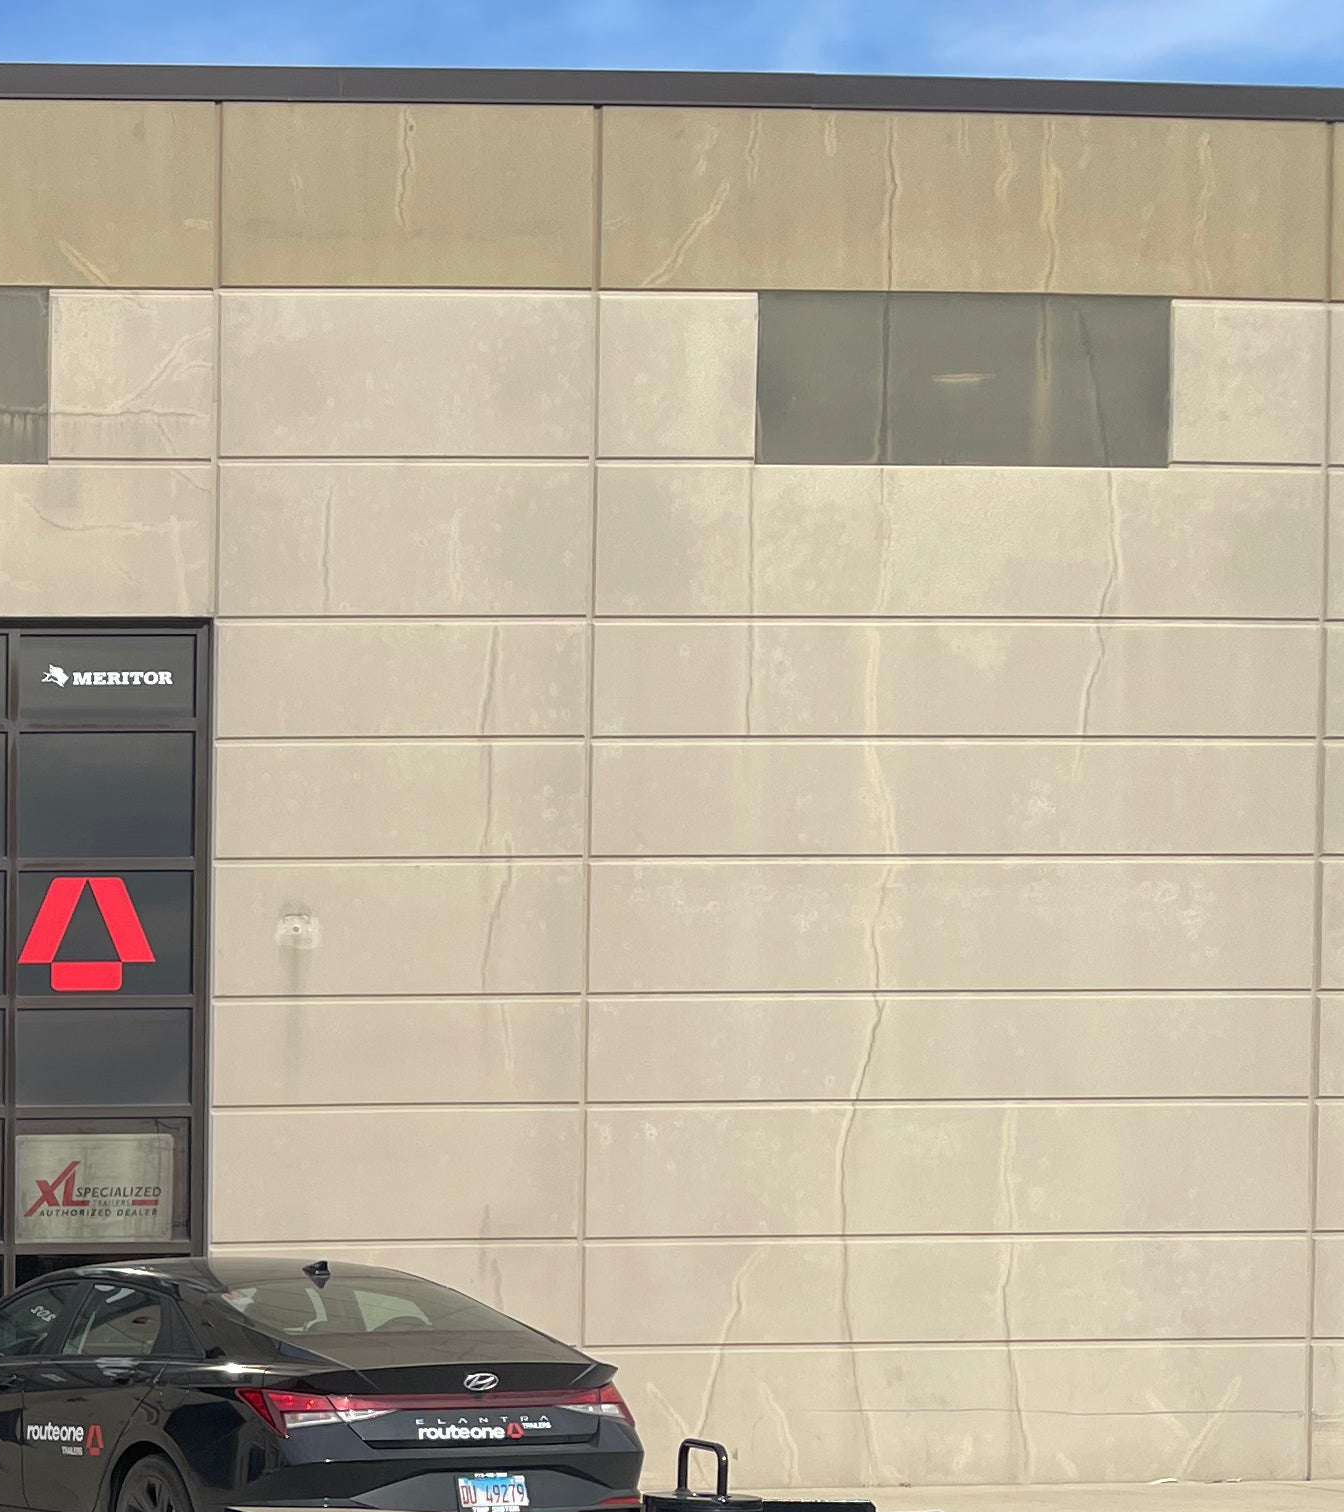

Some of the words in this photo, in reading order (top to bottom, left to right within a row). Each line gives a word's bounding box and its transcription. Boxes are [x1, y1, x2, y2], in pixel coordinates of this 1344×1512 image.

[73, 671, 173, 685] MERITOR
[23, 1160, 90, 1217] XL
[76, 1186, 162, 1198] SPECIALIZED
[39, 1208, 112, 1217] AUTHORIZED
[117, 1207, 158, 1216] DEALER
[415, 1415, 549, 1425] ELANTRA
[27, 1422, 84, 1442] routeone
[418, 1424, 505, 1440] routeone
[461, 1485, 478, 1505] DU
[486, 1483, 525, 1504] 49279
